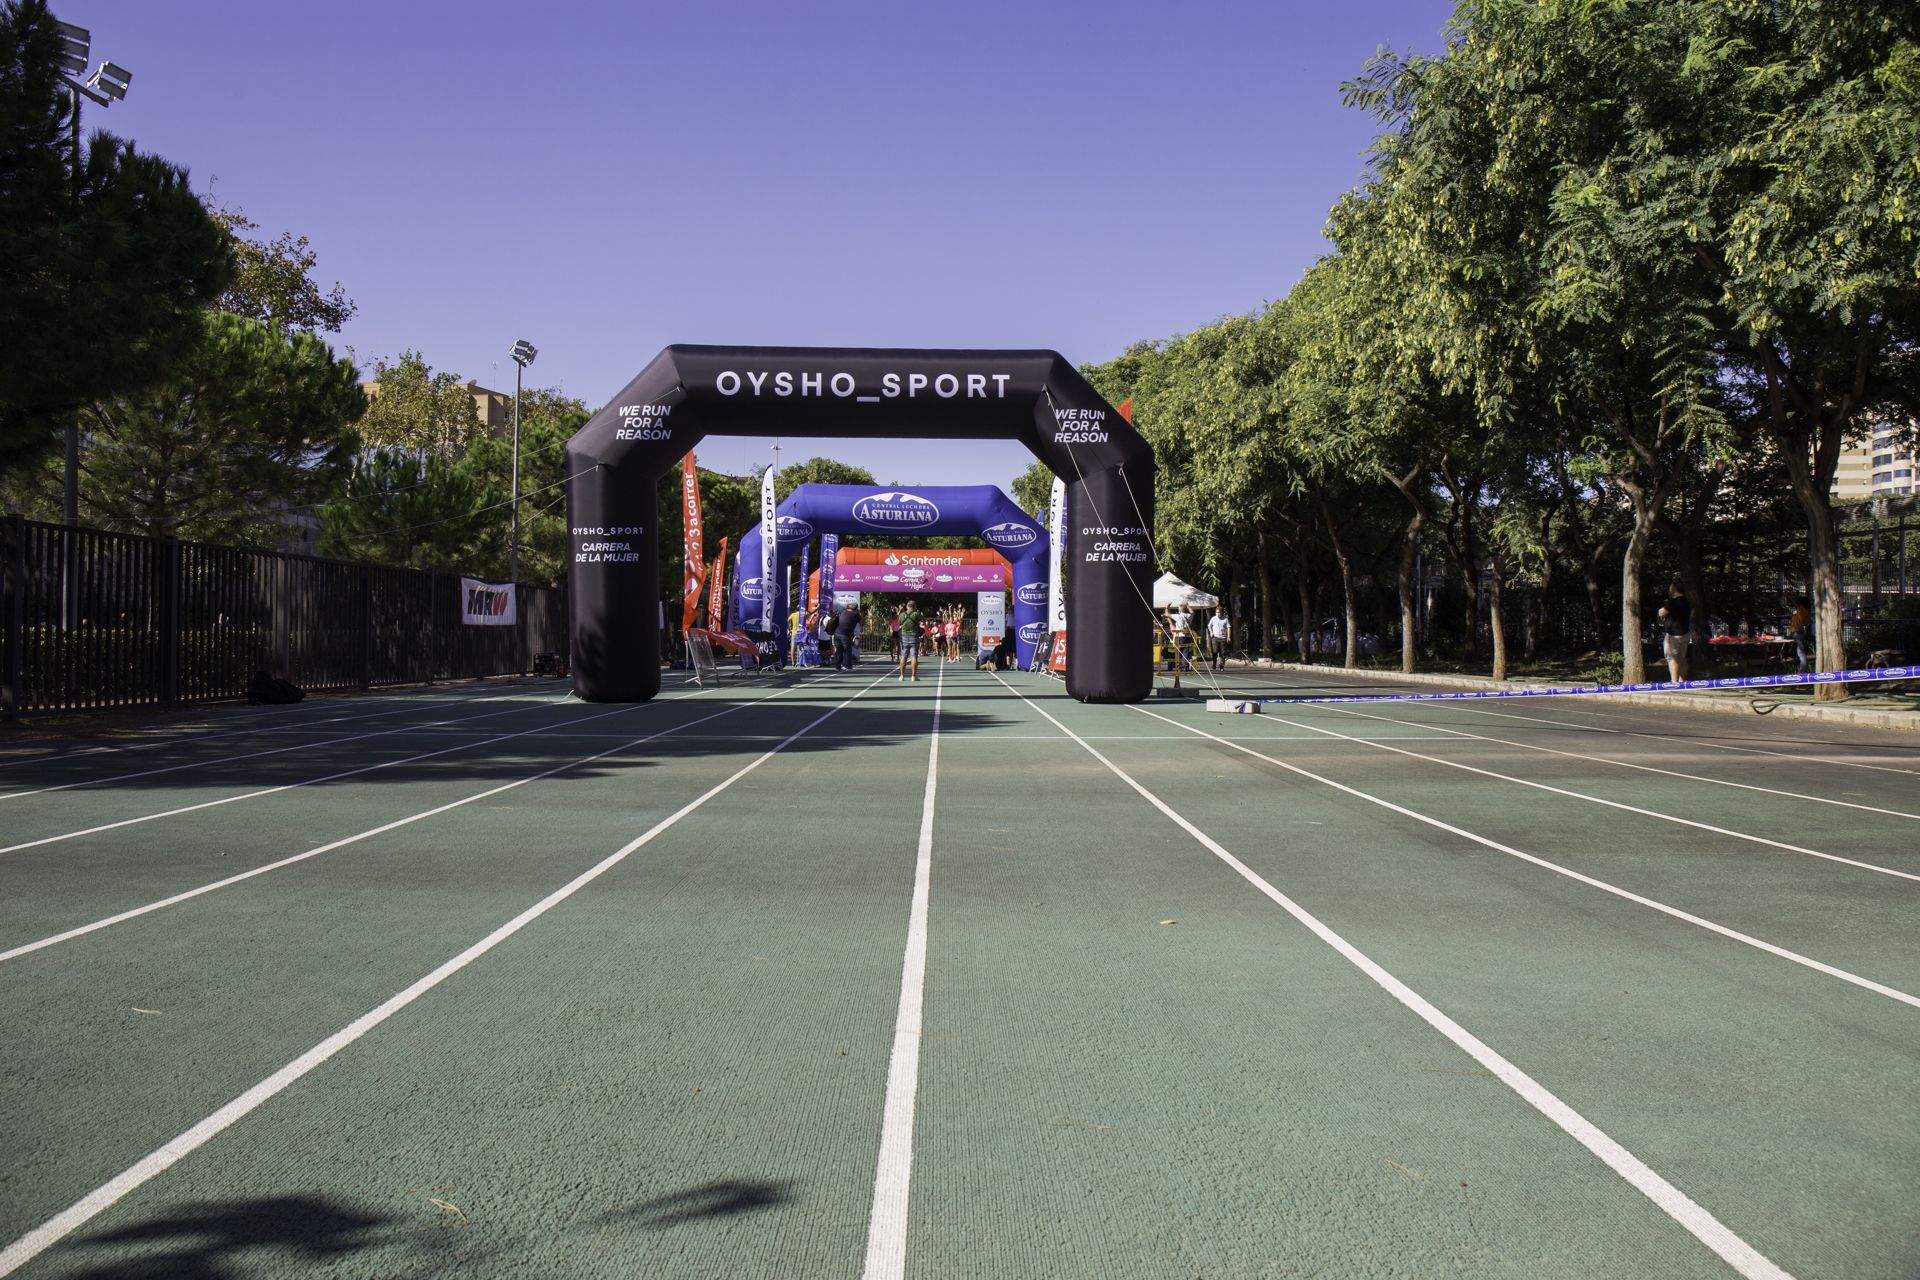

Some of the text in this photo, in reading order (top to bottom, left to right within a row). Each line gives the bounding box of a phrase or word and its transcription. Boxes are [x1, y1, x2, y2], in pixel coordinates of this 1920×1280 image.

[716, 371, 1010, 403] OYSHO_SPORT
[619, 405, 671, 416] WE RUN
[1055, 409, 1105, 421] WE RUN
[624, 417, 664, 429] FOR A
[1062, 421, 1100, 432] FOR A
[615, 429, 671, 441] REASON
[1054, 432, 1108, 443] REASON
[859, 503, 933, 522] ASTURIANA
[572, 527, 644, 536] OYSHO_SPORT
[777, 528, 809, 536] URIANA
[986, 532, 1033, 542] ASTURIANA
[581, 542, 631, 552] CARRERA
[1093, 542, 1141, 551] CARRERA
[575, 552, 639, 562] DE LA MUJER
[902, 555, 963, 566] Santander
[1085, 552, 1147, 562] DE LA MUJER
[467, 589, 509, 616] MRW
